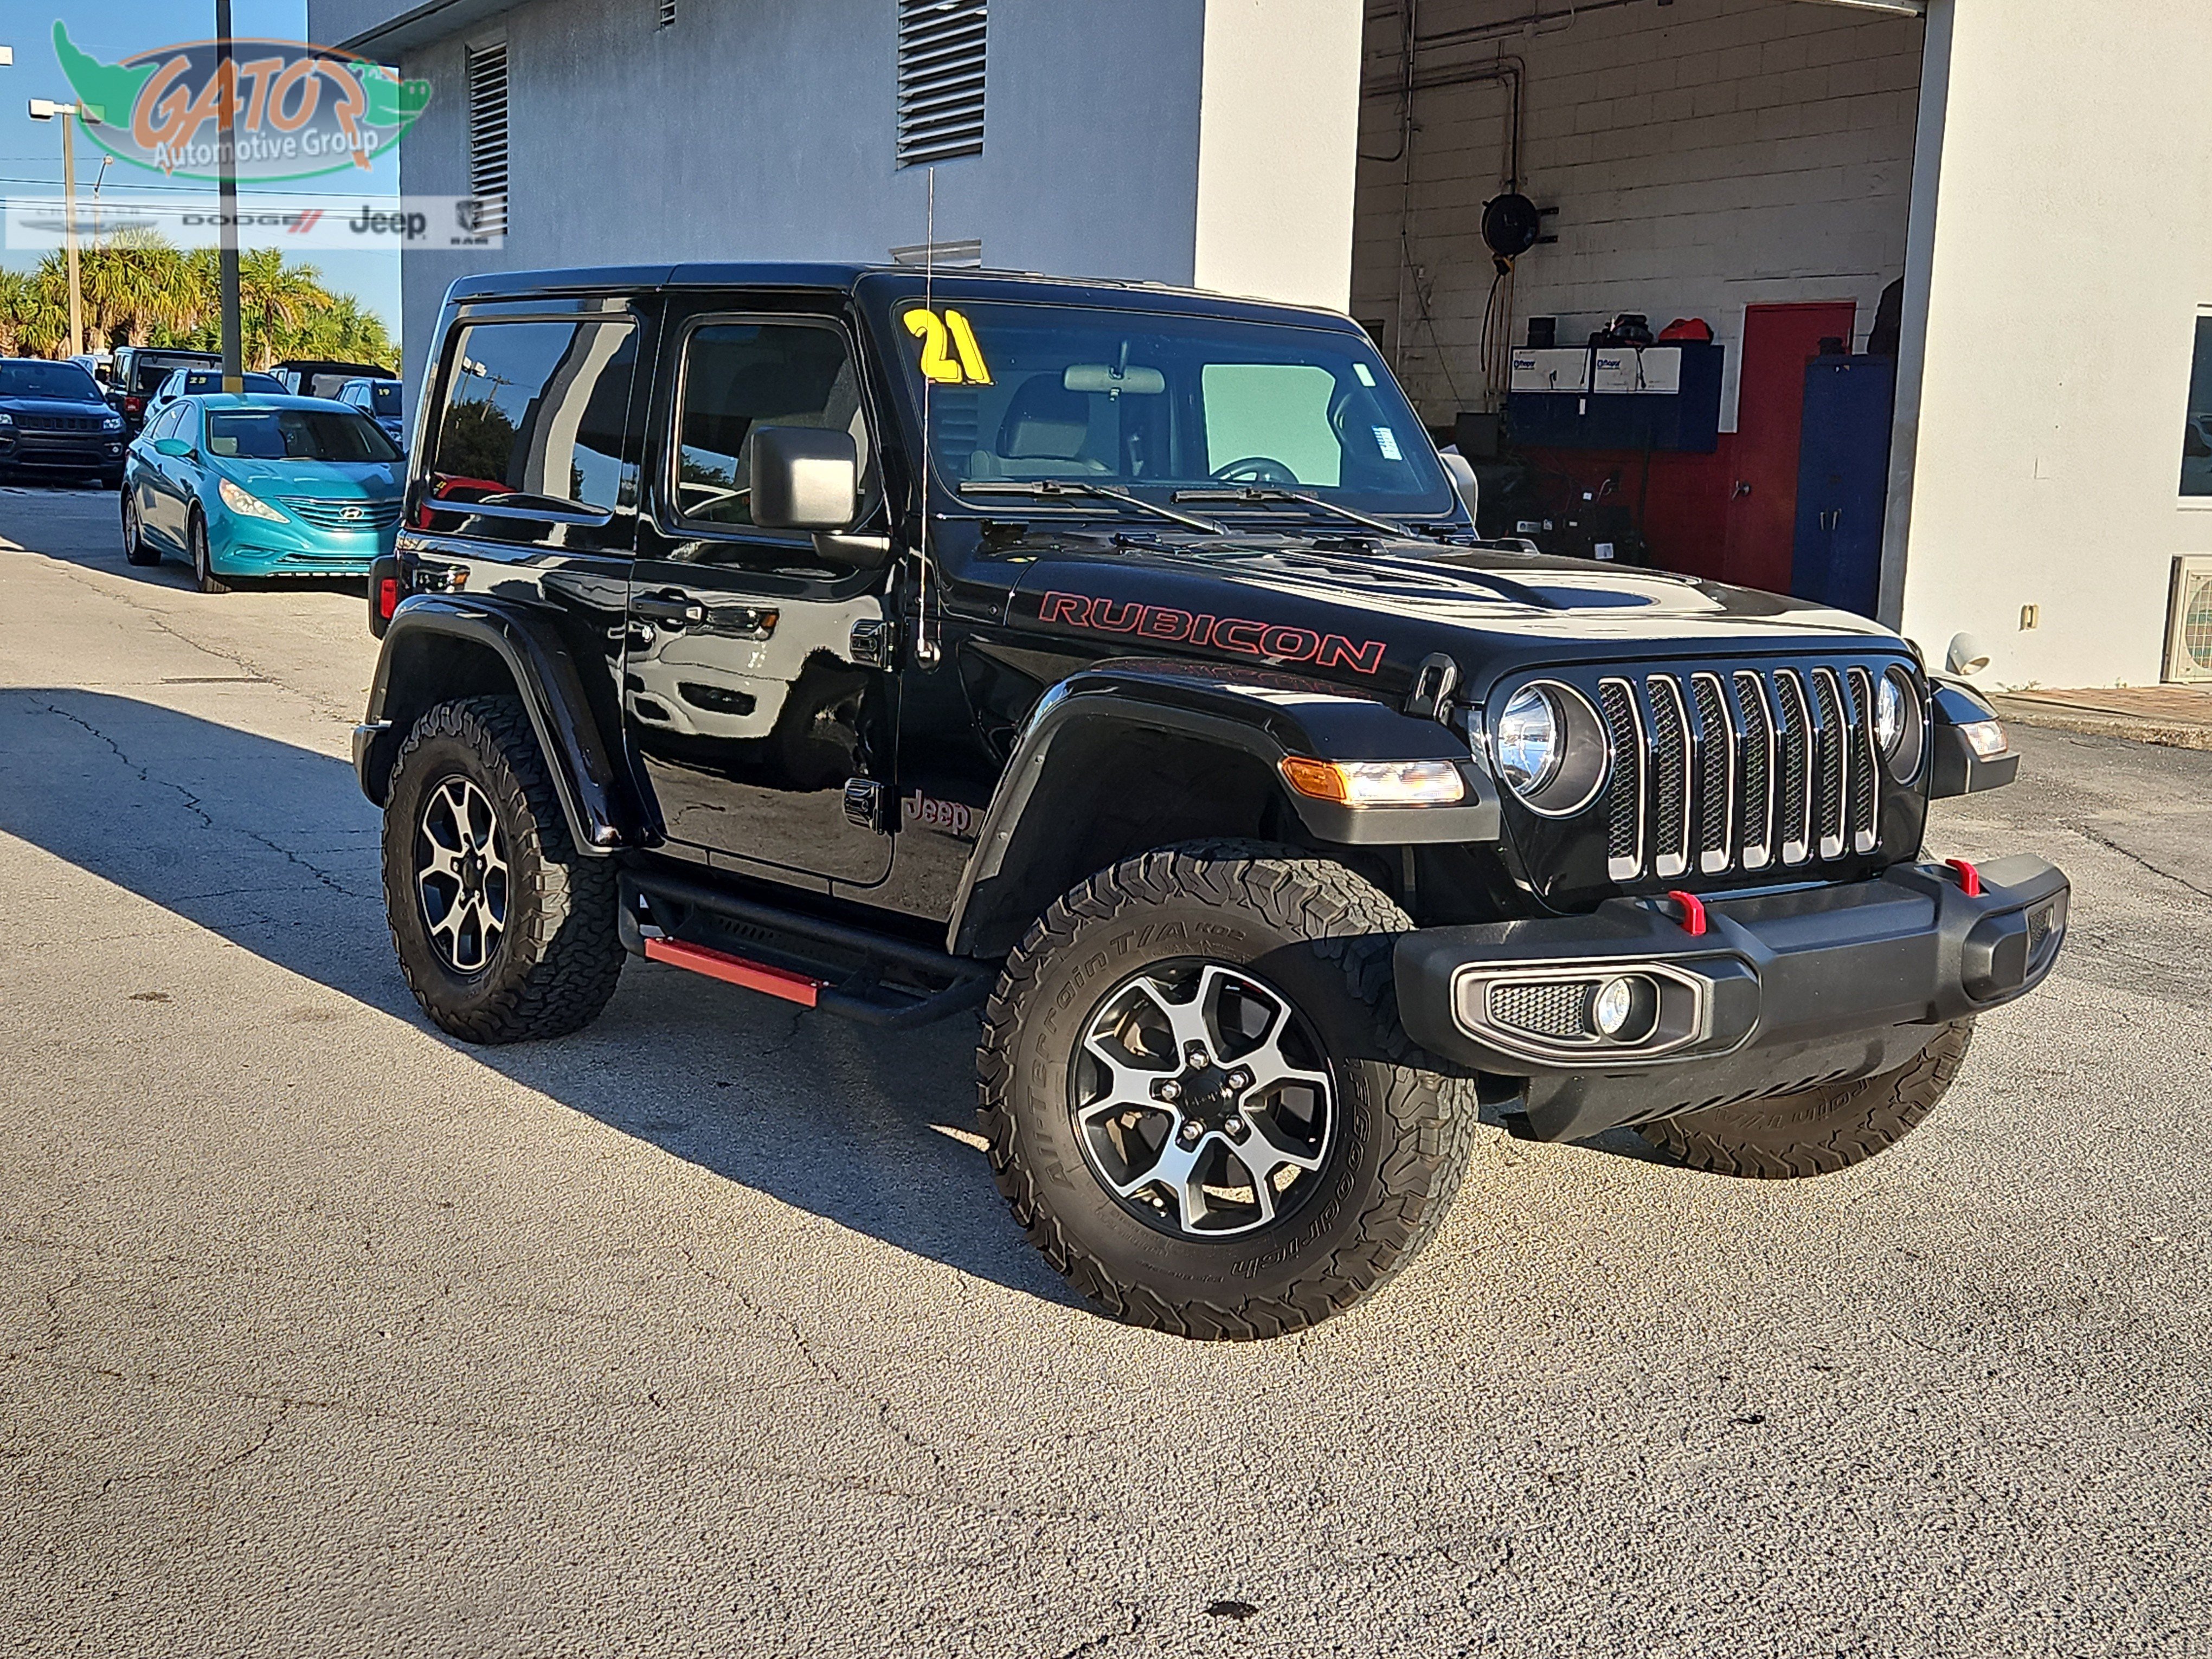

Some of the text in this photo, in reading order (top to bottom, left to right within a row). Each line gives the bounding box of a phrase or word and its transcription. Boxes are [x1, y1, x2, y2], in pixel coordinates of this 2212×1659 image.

[904, 309, 991, 383] 21
[1038, 591, 1387, 674] RUBICON
[906, 788, 972, 837] Jeep
[1110, 922, 1188, 956] T/A
